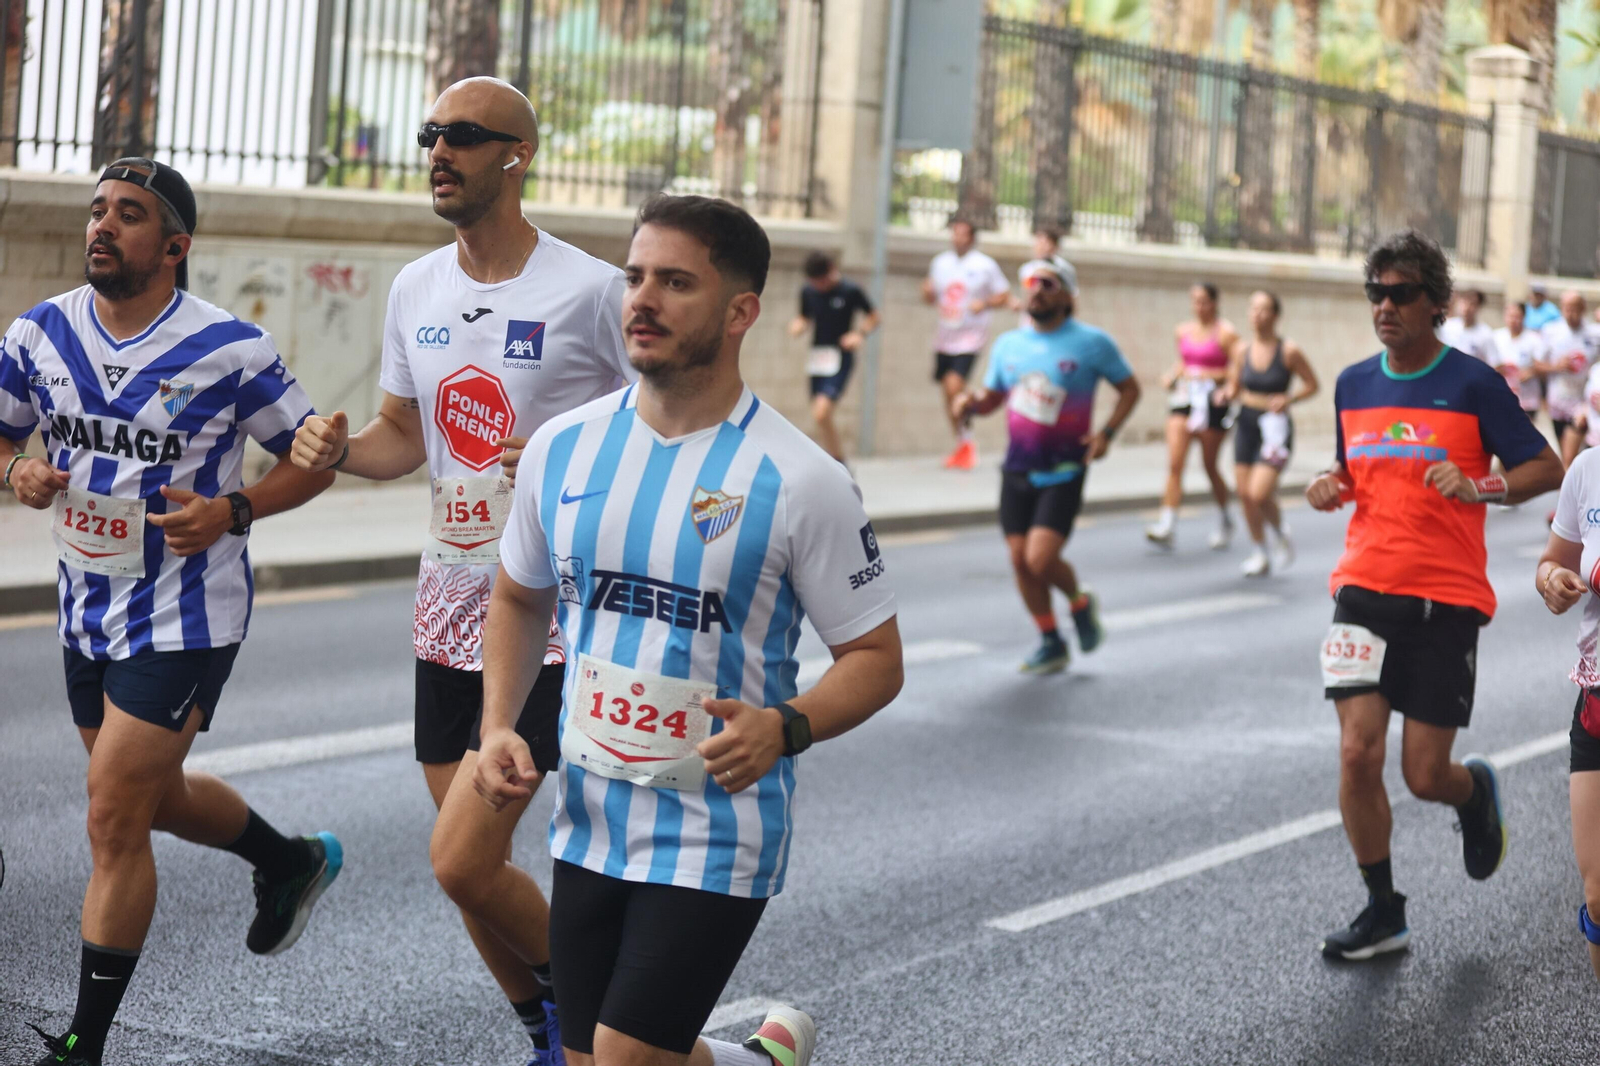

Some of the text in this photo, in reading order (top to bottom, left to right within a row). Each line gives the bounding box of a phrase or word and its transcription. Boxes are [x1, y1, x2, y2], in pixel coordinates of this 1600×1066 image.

[502, 360, 541, 371] fundación
[503, 340, 535, 357] AXA
[446, 408, 501, 447] FRENO
[448, 389, 505, 429] PONLE
[48, 412, 182, 465] MALAGA
[64, 507, 128, 539] 1278
[446, 500, 491, 523] 154
[588, 569, 733, 634] TESESA
[590, 691, 688, 739] 1324
